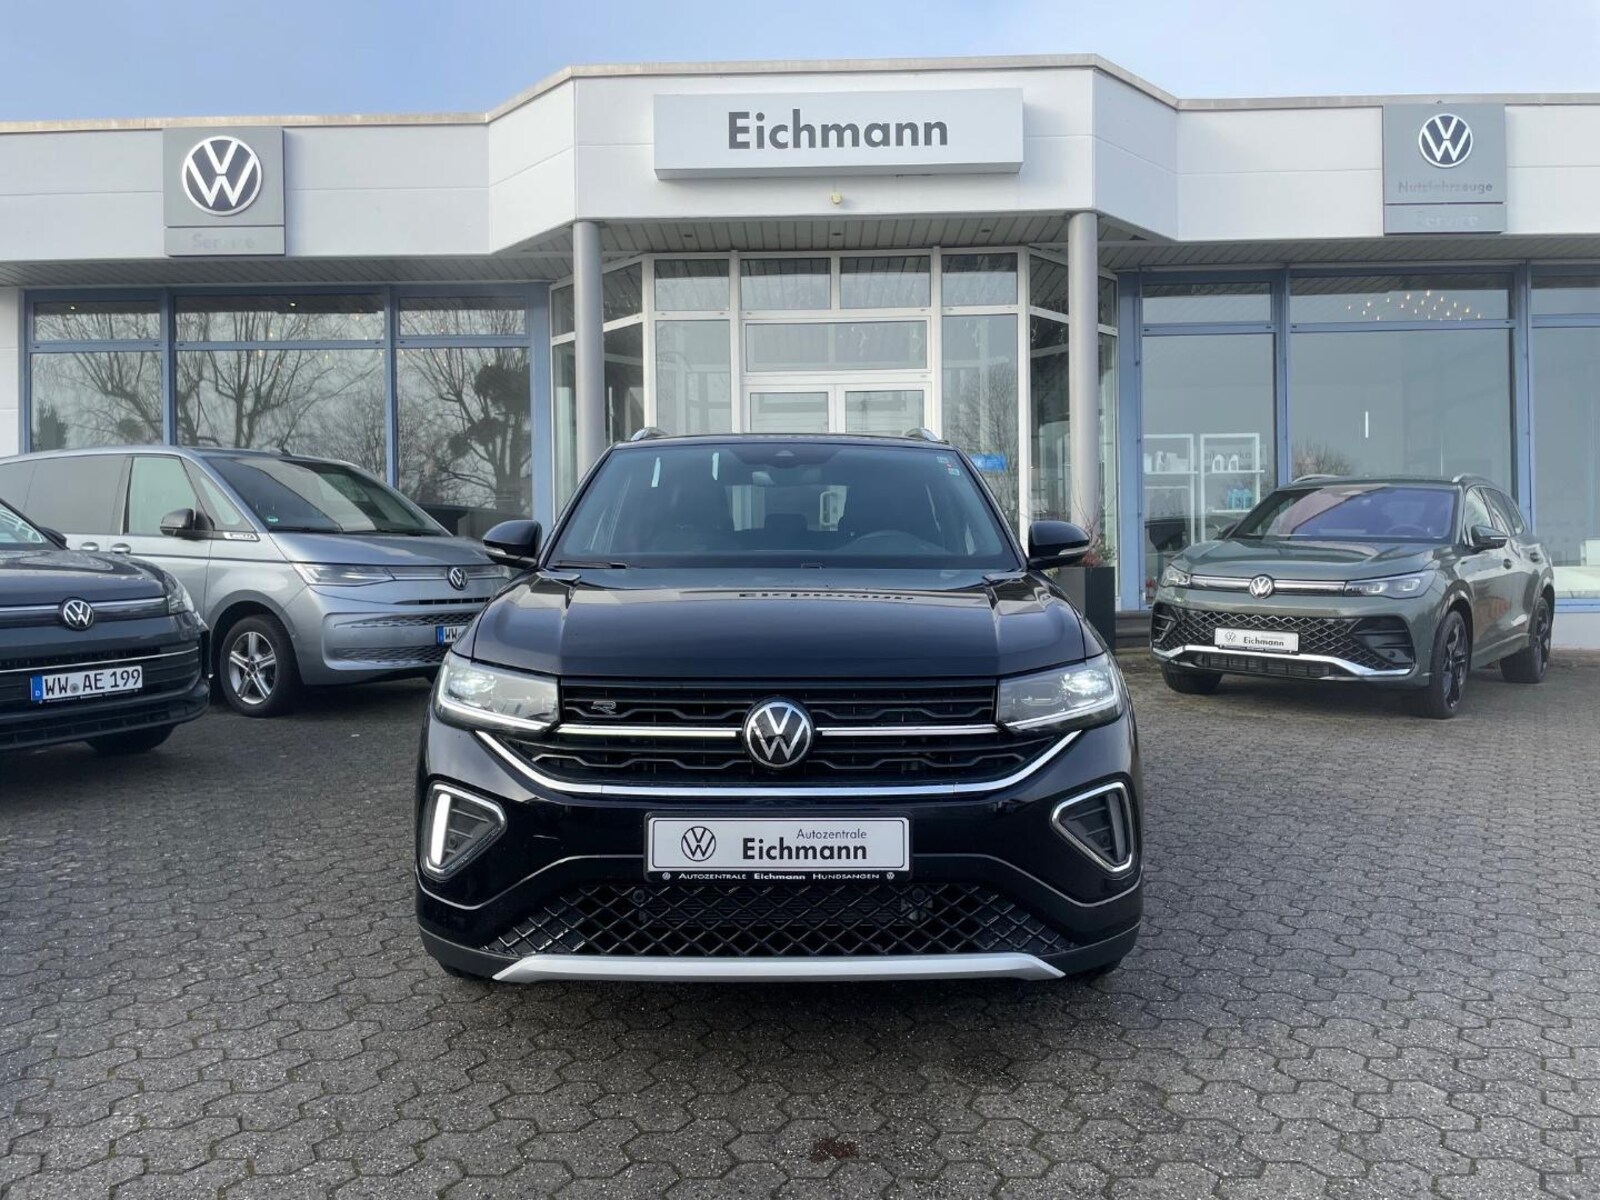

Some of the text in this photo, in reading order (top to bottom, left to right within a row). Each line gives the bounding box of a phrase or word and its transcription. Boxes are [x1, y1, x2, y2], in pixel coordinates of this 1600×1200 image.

[728, 109, 948, 149] Eichmann
[1243, 636, 1284, 647] Eichmann
[44, 676, 69, 696] WW
[83, 672, 105, 692] AE
[110, 668, 141, 689] 199
[796, 828, 868, 840] Autozentrale
[742, 837, 868, 860] Eichmann
[754, 872, 806, 880] Eichmann
